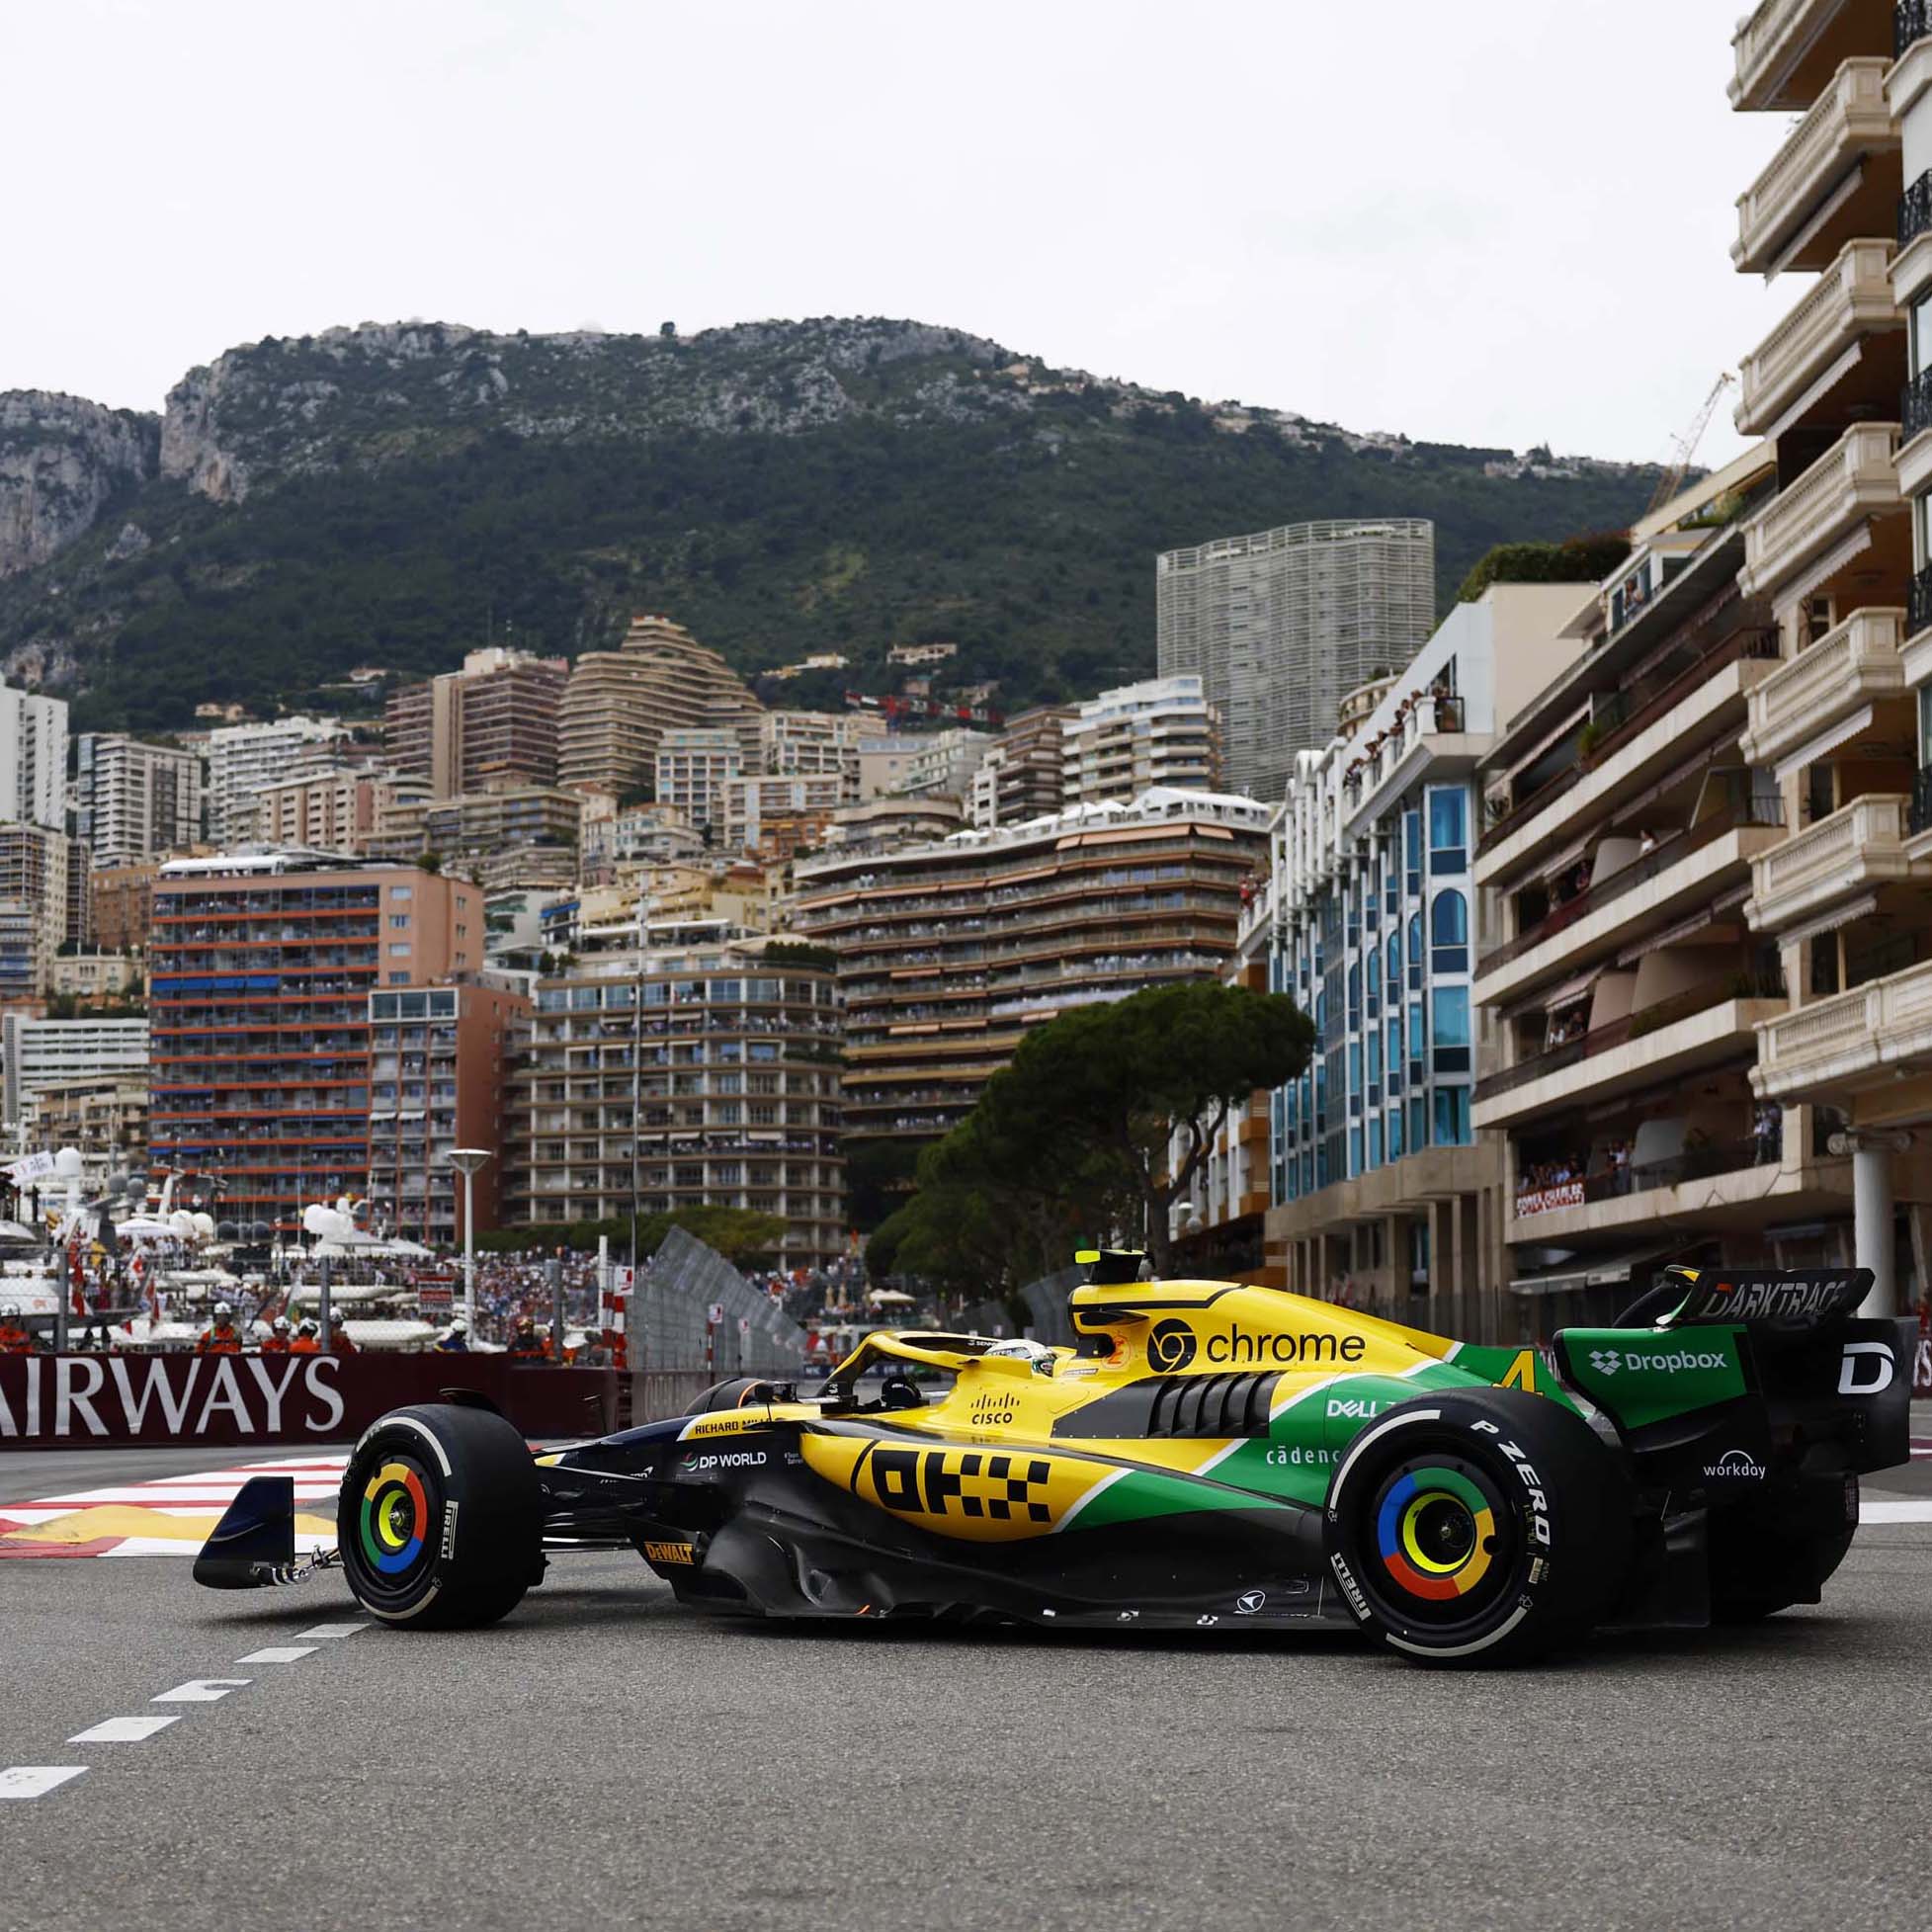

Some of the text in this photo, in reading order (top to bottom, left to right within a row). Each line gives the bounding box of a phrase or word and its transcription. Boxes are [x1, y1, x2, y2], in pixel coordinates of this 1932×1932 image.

[1207, 1324, 1366, 1363] chrome
[1625, 1351, 1727, 1374] Dropbox
[1327, 1399, 1378, 1418] DELL
[695, 1421, 739, 1434] RICHARD
[699, 1455, 717, 1470] DP
[718, 1452, 767, 1468] WORLD
[1266, 1445, 1342, 1465] cādenc
[1470, 1419, 1500, 1434] P
[1497, 1440, 1551, 1546] ZERO
[1703, 1463, 1766, 1479] workday
[872, 1450, 1051, 1523] OKX
[441, 1499, 459, 1560] PIRELLI
[1330, 1552, 1372, 1621] PIRELLI
